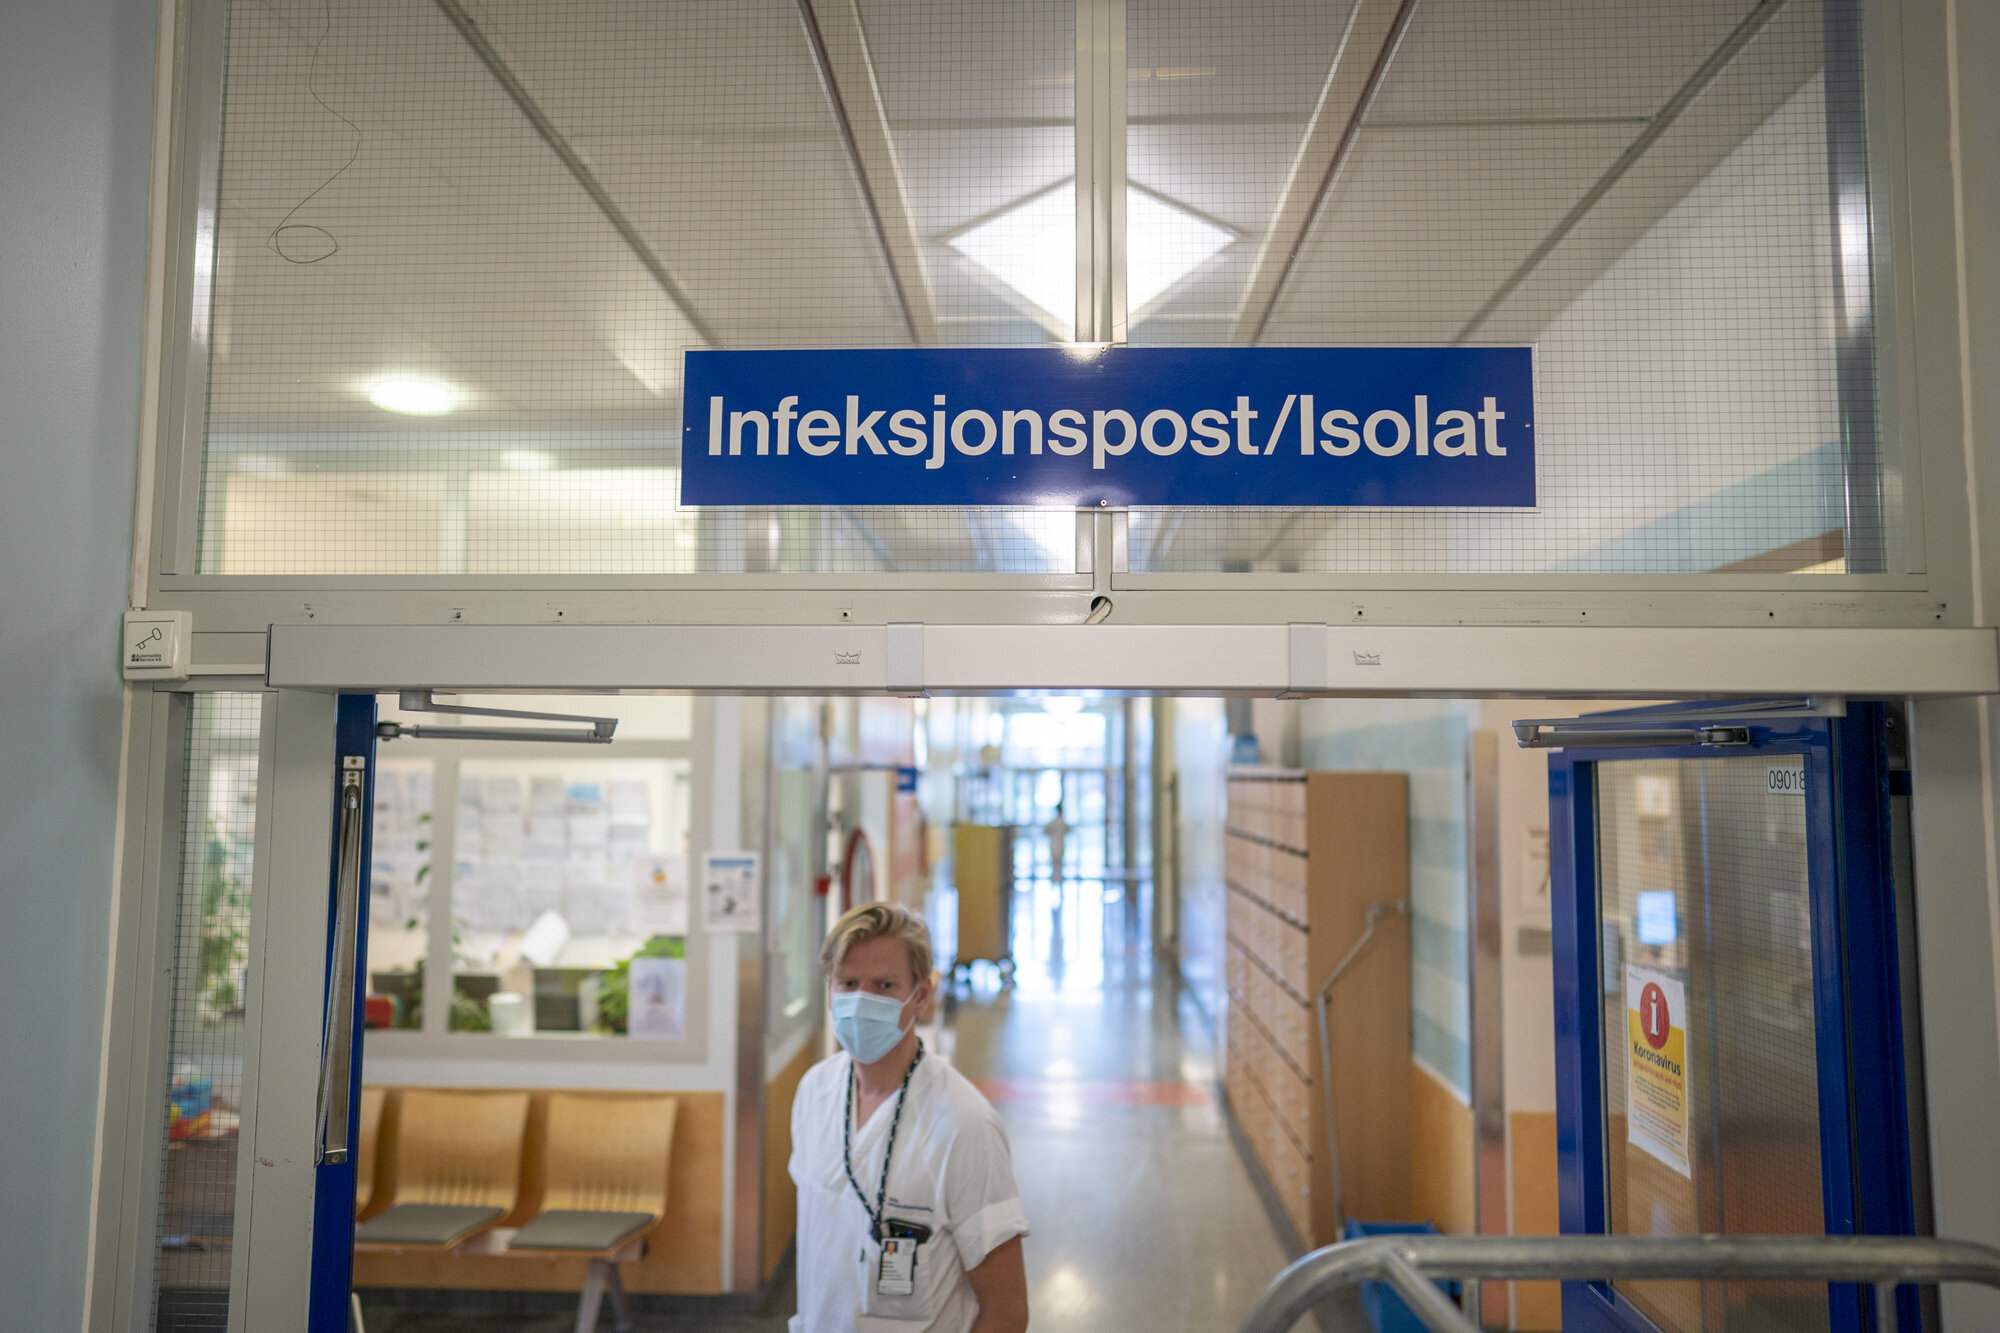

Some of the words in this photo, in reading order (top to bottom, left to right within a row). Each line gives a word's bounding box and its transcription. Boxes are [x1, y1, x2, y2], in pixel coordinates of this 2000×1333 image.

[708, 394, 1507, 470] Infeksjonspost/Isolat
[1769, 770, 1805, 790] 09018
[1633, 1040, 1682, 1076] Koronavirus
